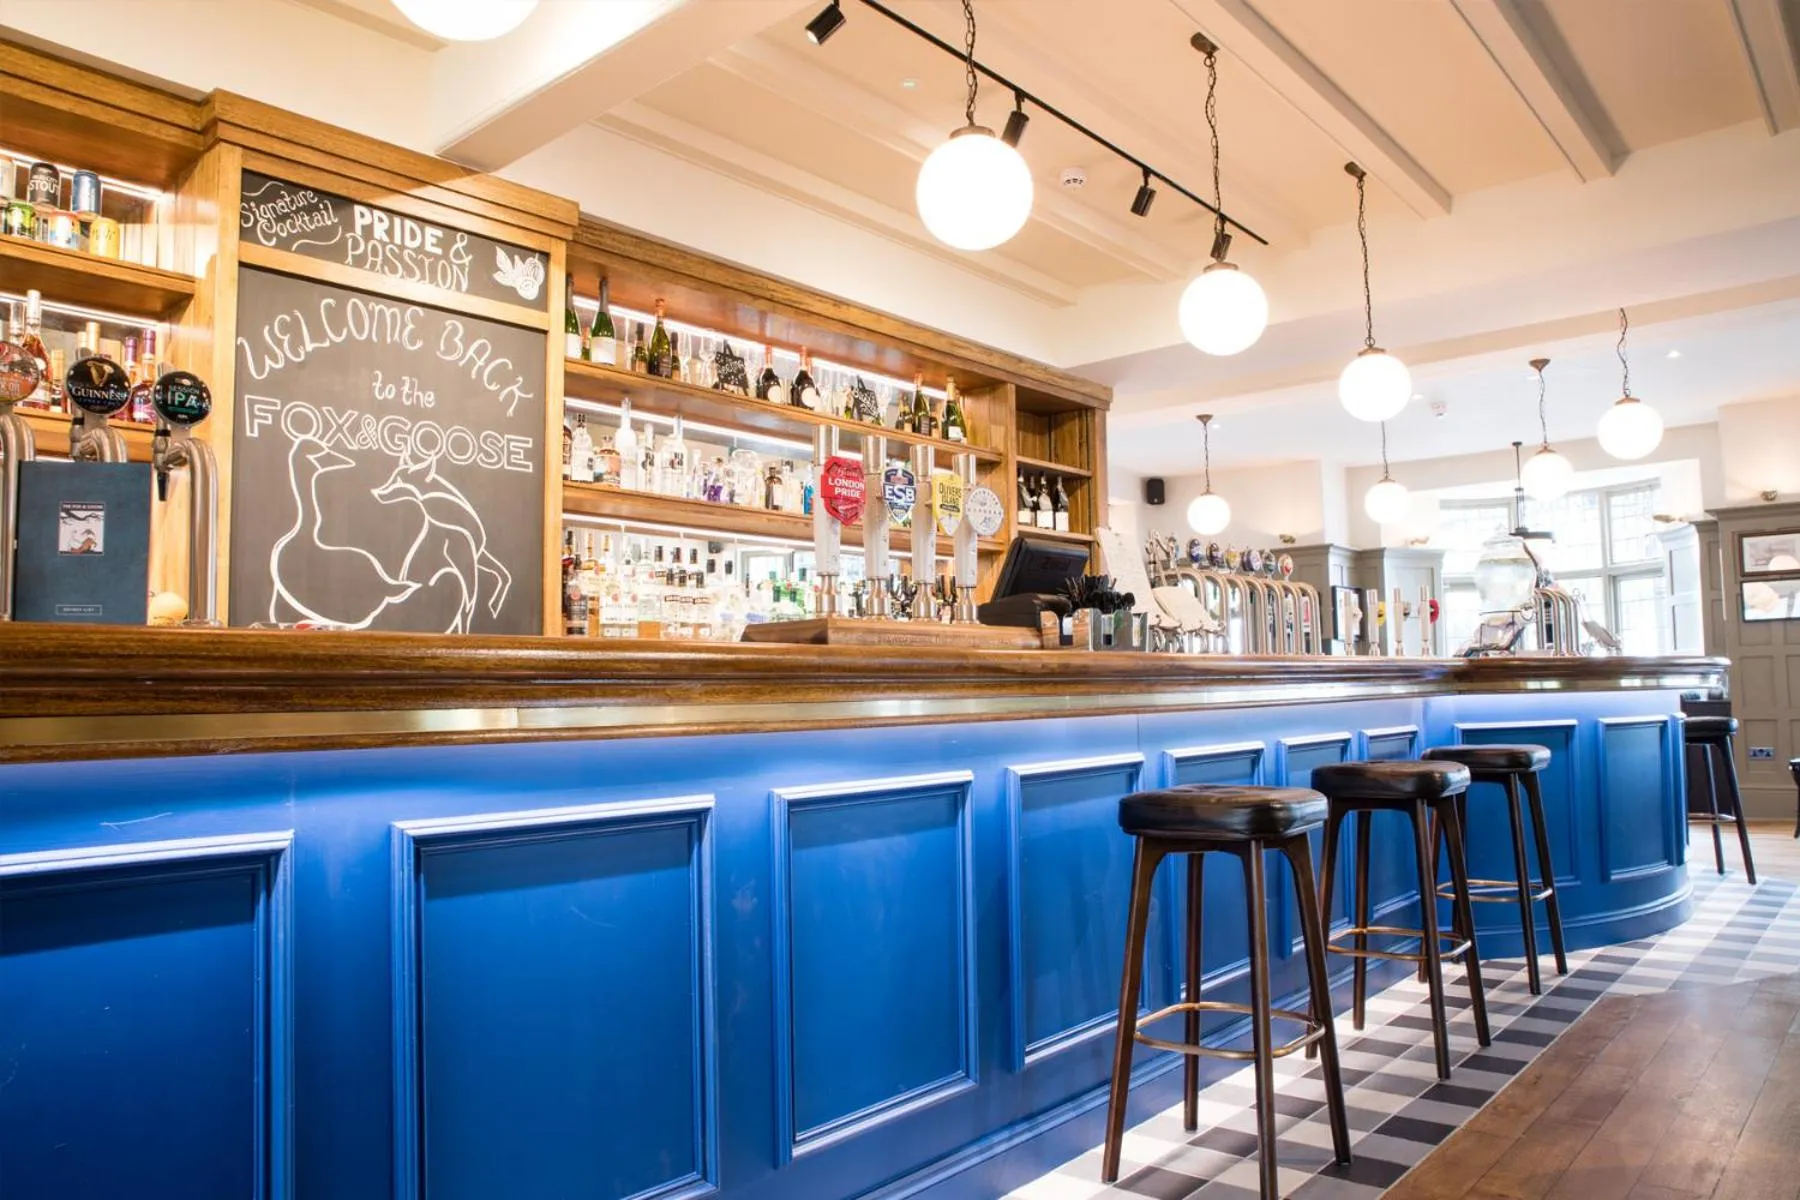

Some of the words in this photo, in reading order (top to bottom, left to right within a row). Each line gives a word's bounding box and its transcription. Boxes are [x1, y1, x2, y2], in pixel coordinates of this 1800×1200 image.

[240, 190, 318, 233] Signature
[257, 200, 338, 246] Cocktail
[353, 203, 444, 255] PRIDE
[449, 231, 473, 264] &
[345, 232, 469, 292] PASSION
[237, 297, 425, 380] WELCOME
[435, 319, 533, 418] BACK
[372, 370, 396, 400] to
[401, 376, 436, 408] the
[828, 477, 865, 491] LONDON
[834, 487, 862, 498] PRIDE
[885, 485, 915, 502] ESB
